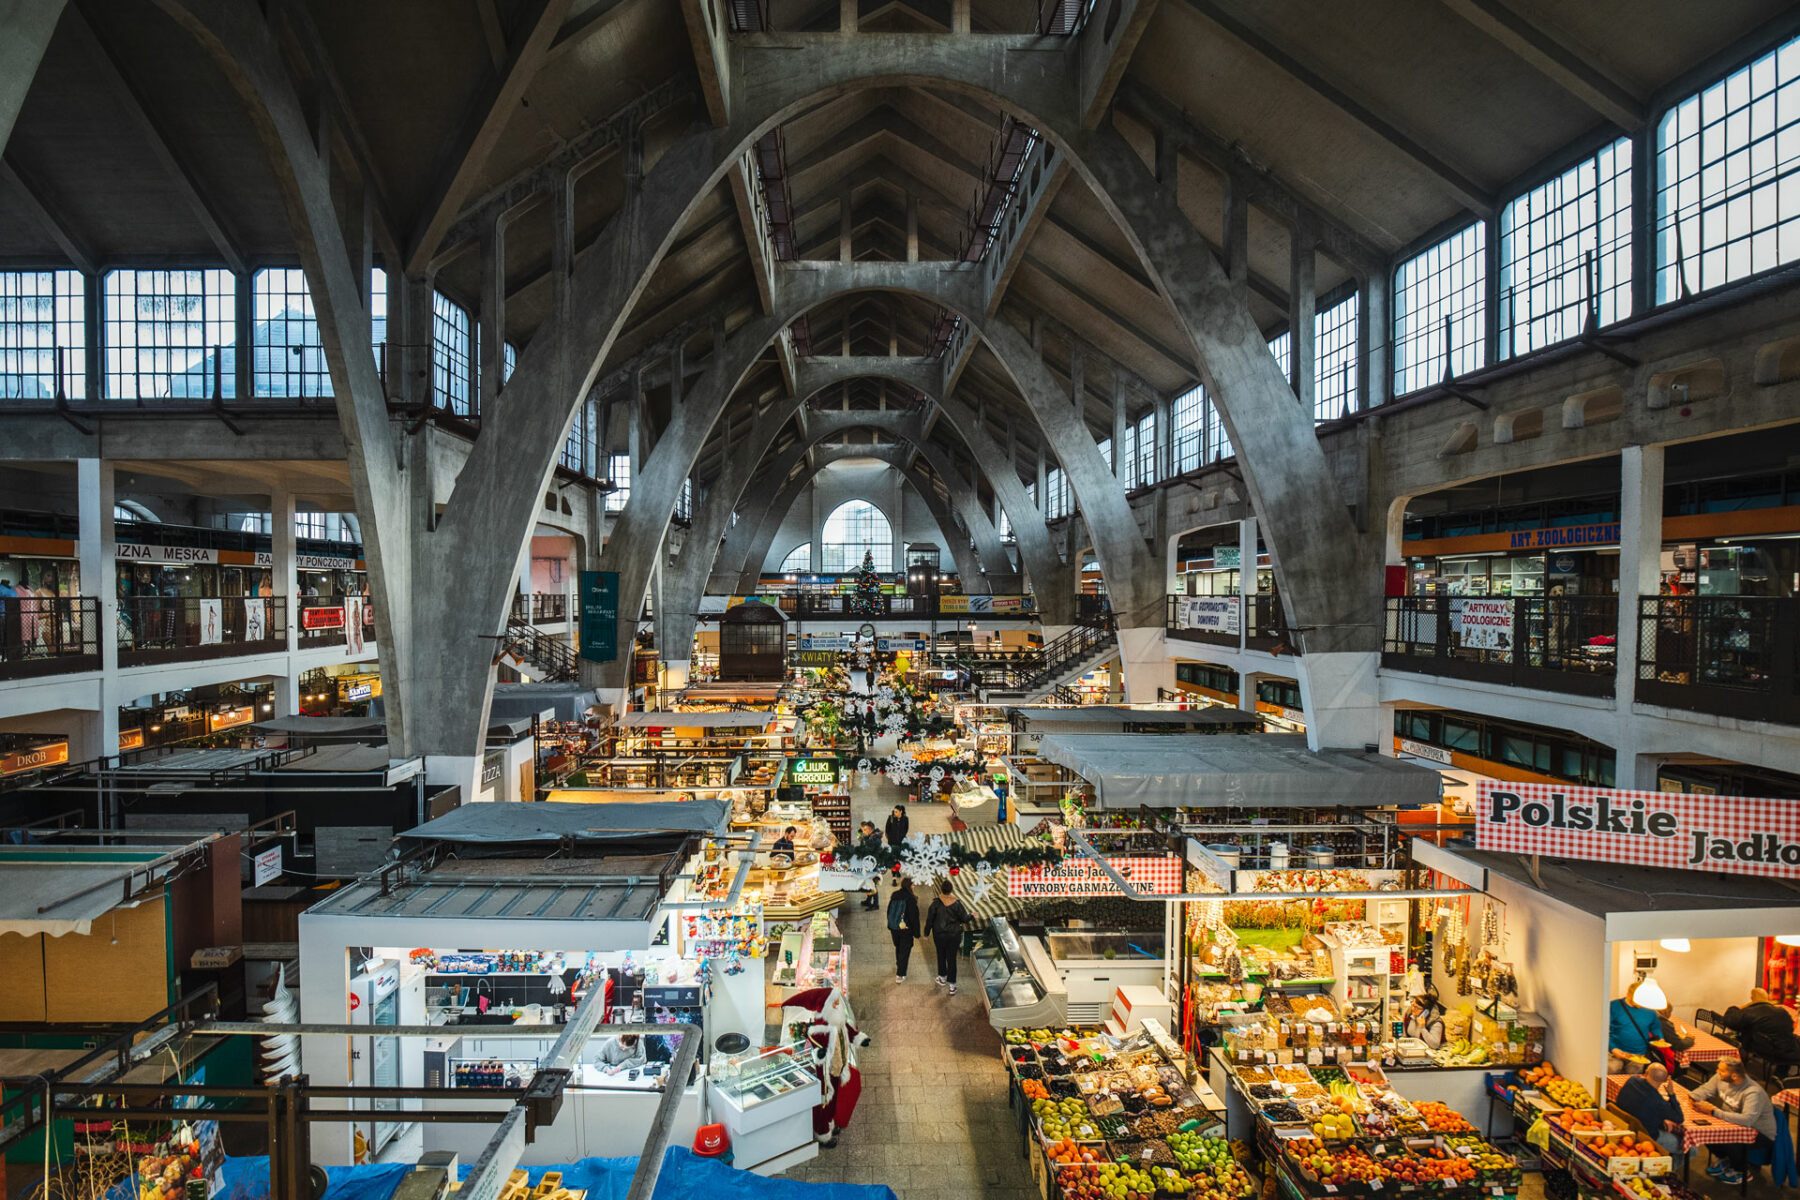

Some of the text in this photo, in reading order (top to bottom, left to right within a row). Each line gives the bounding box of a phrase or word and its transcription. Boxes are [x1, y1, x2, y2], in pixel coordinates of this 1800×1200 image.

[1511, 524, 1621, 548] ART. ZOOLOGICZNE
[115, 544, 209, 561] IZNA MĘSKA
[1469, 603, 1505, 614] ARTYKUŁY
[1462, 615, 1511, 627] ZOOLOGICZNE
[801, 652, 832, 662] KWIATY
[482, 765, 501, 783] IZZA
[792, 772, 835, 783] TARGOWA
[1490, 791, 1678, 837] Polskie
[1689, 830, 1800, 864] Jadło
[1044, 866, 1084, 877] Polskie
[1023, 880, 1154, 893] WYROBY GARMAŻEYJNE
